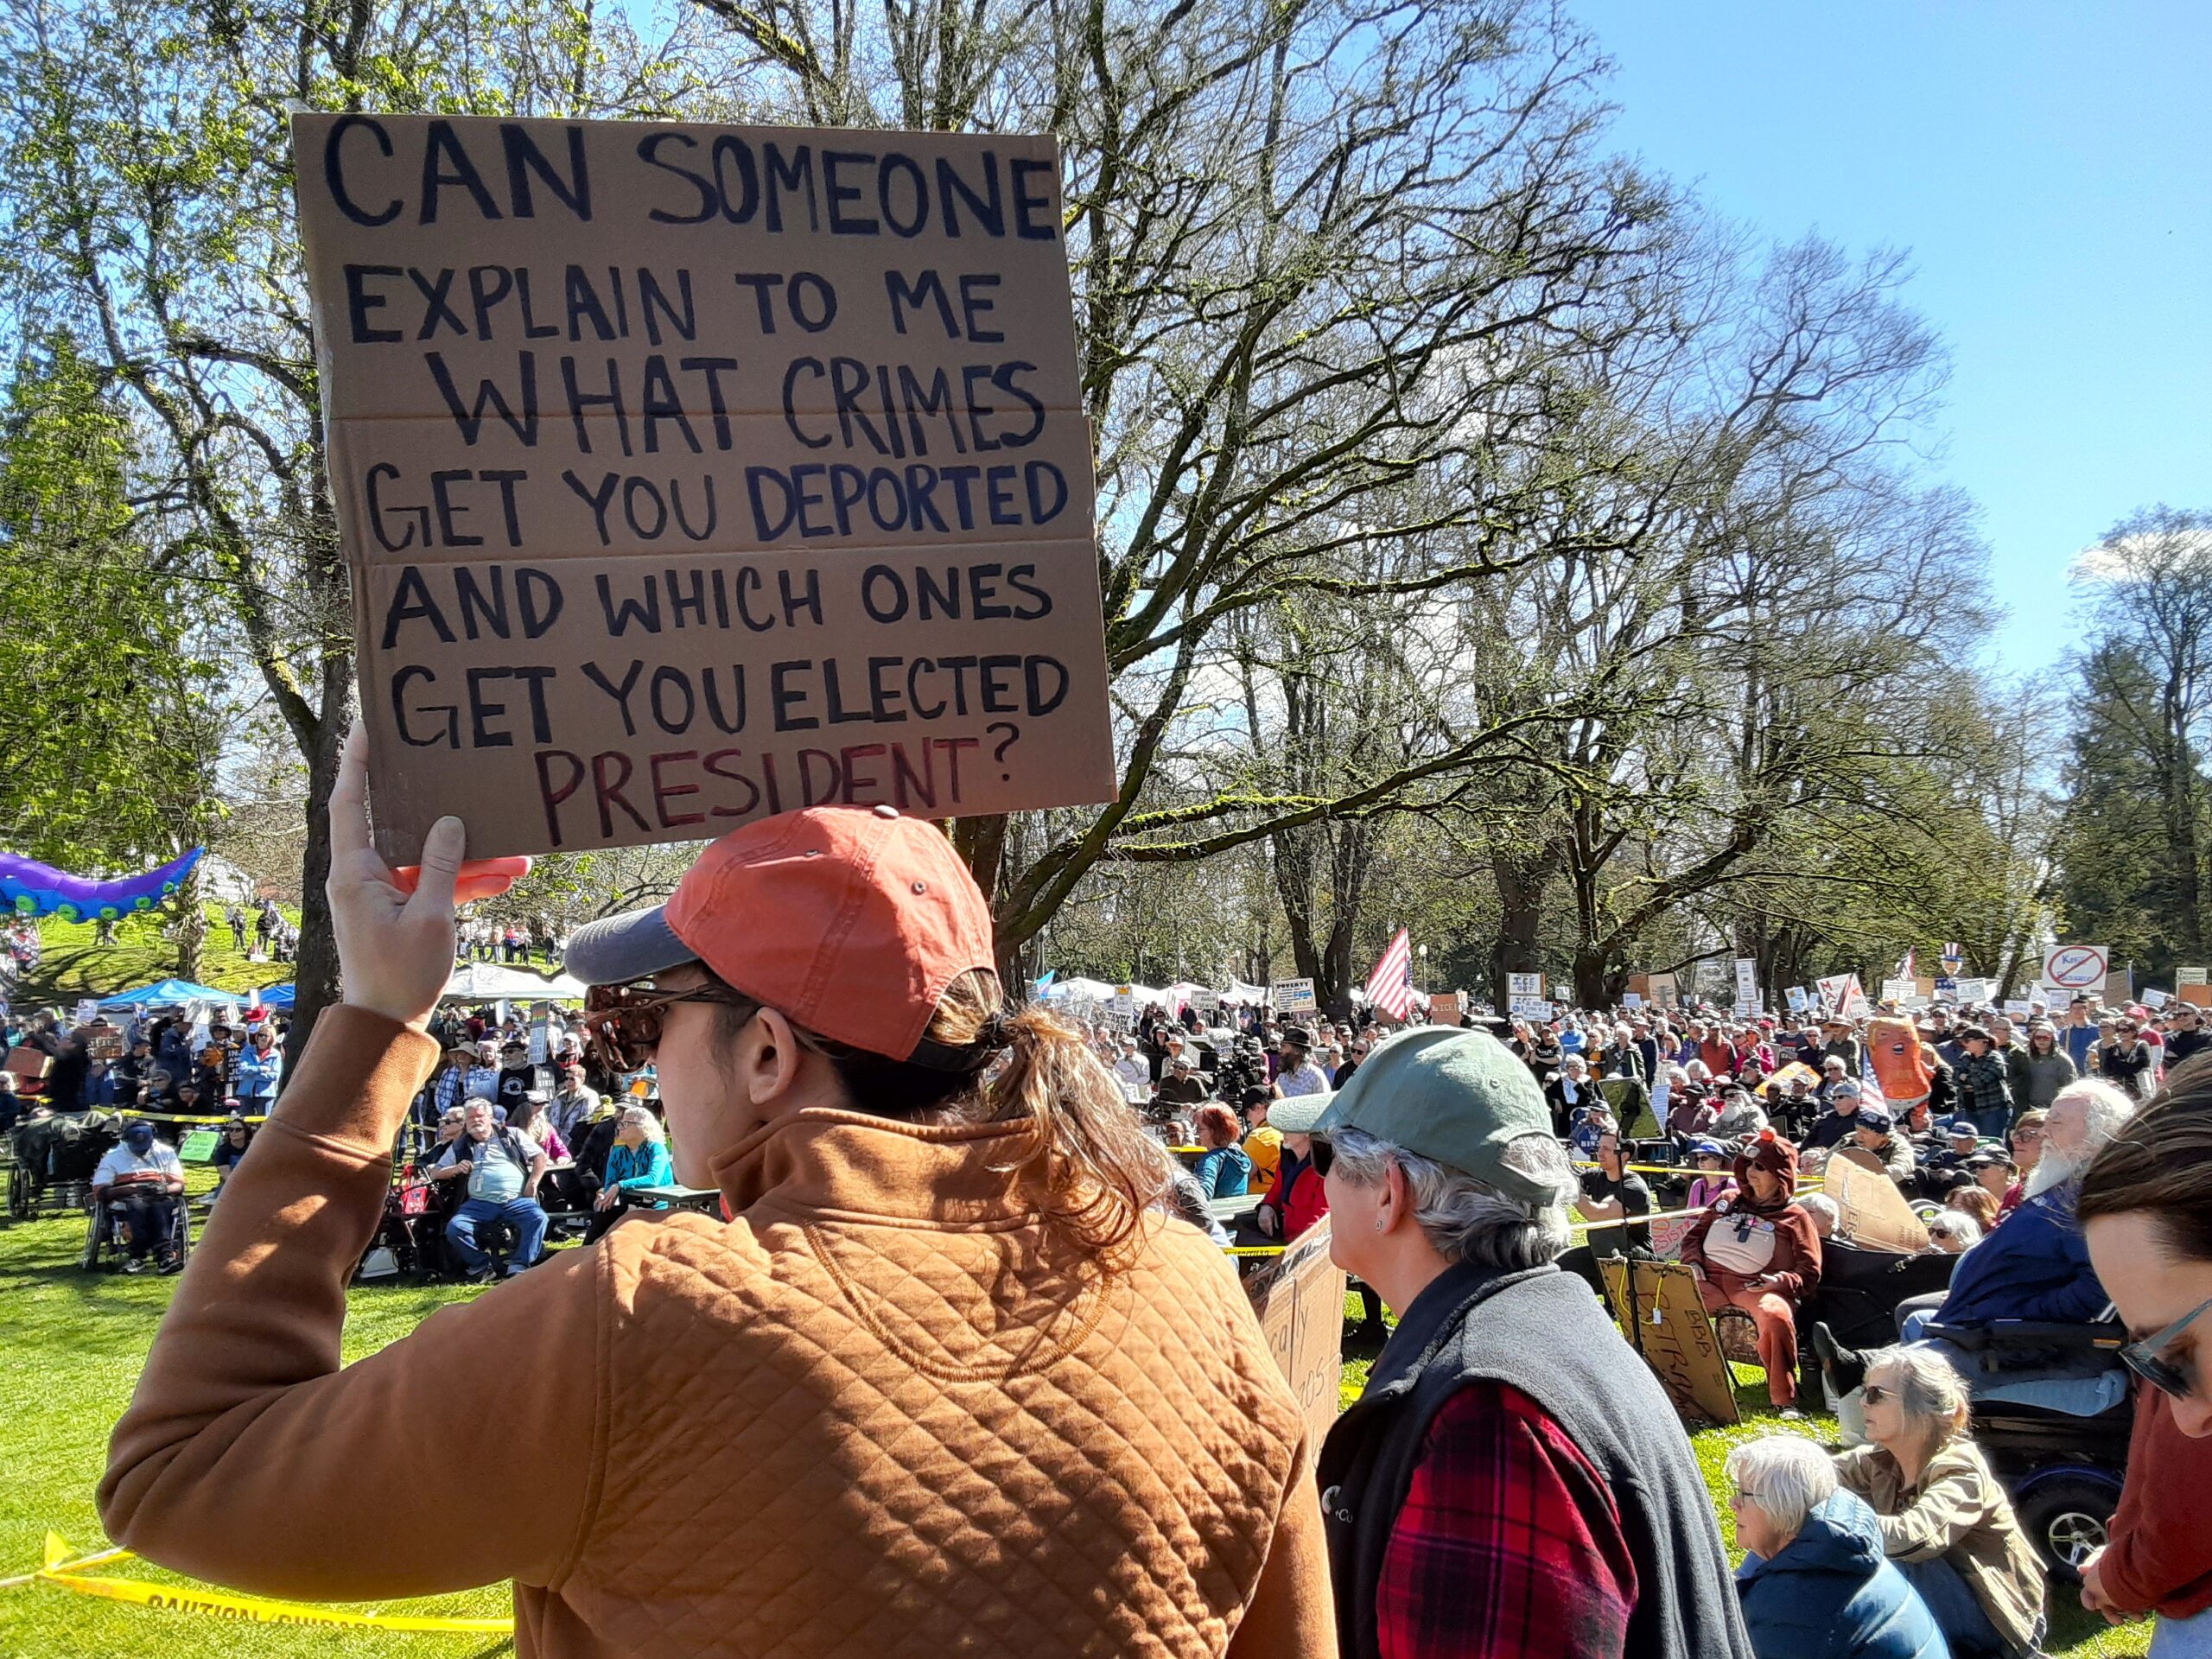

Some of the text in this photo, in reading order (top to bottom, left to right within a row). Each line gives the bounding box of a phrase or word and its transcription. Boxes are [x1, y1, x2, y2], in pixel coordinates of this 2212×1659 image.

[325, 119, 1057, 242] CAN SOMEONE
[346, 264, 1006, 345] EXPLAIN TO ME
[424, 351, 1046, 459] WHAT CRIMES
[365, 461, 1069, 553] GET YOU DEPORTED
[382, 563, 1053, 649] AND WHICH ONES
[391, 654, 1071, 750] GET YOU ELECTED
[533, 721, 1021, 848] PRESIDENT?
